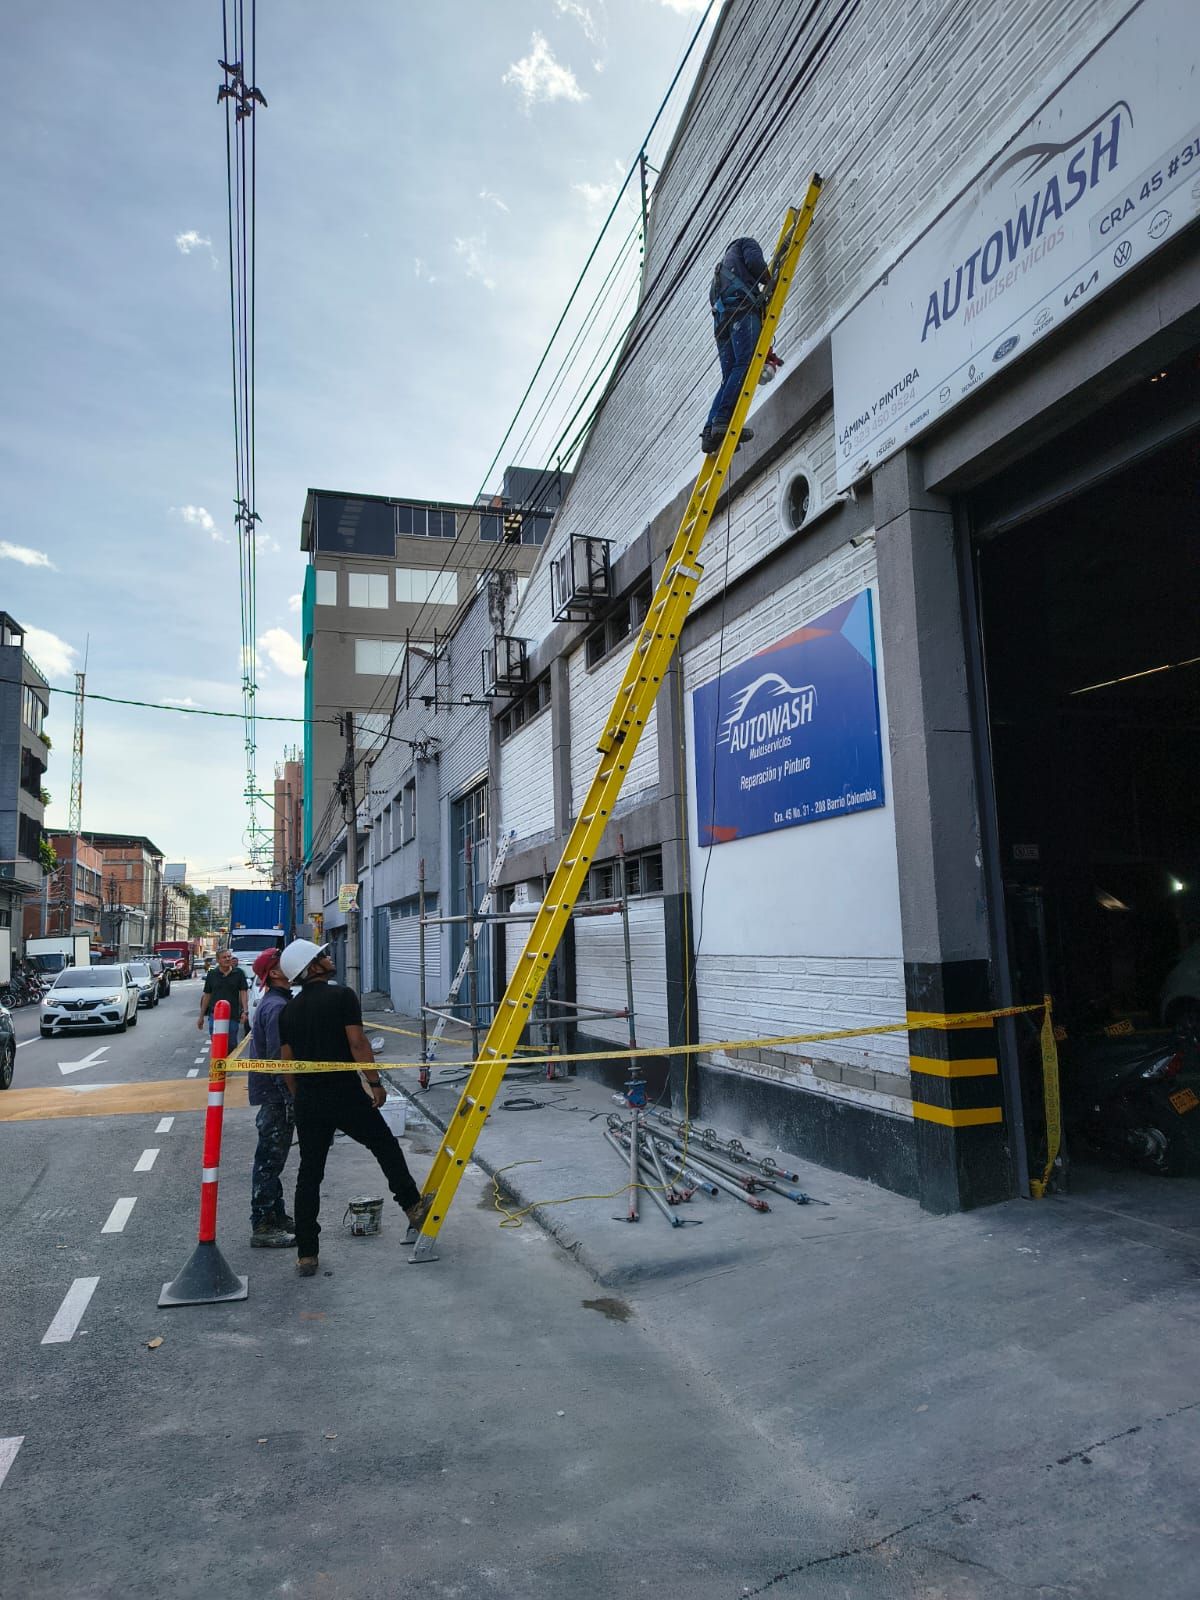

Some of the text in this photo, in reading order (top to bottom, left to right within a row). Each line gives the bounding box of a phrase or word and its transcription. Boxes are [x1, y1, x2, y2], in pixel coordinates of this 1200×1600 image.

[921, 112, 1121, 343] AUTOWASH
[1100, 197, 1136, 235] CRA
[1140, 170, 1163, 200] 45
[963, 224, 1066, 326] Multiservicios
[839, 368, 920, 445] LÁMINA Y PINTURA
[730, 691, 813, 754] AUTOWASH
[749, 735, 792, 761] Multiservicios
[740, 755, 811, 791] Reparación y Pintura
[802, 803, 810, 817] 31
[826, 795, 845, 810] Barrio
[846, 788, 877, 806] Colombia
